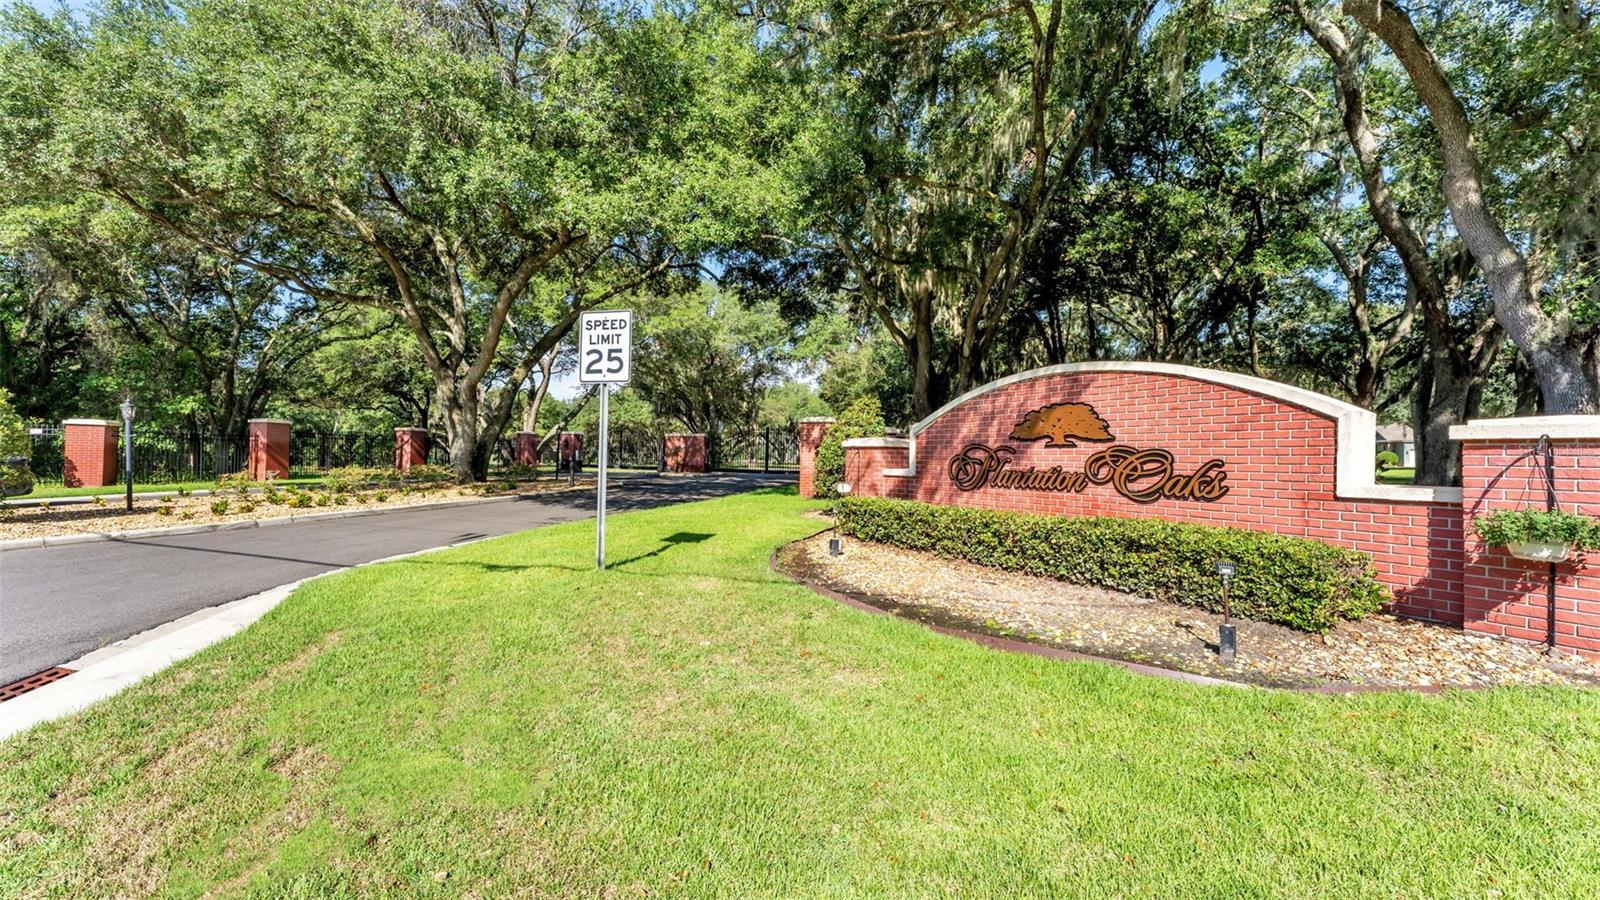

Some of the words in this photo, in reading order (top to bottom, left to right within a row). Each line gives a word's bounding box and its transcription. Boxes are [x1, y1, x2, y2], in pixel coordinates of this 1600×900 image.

[585, 319, 627, 331] SPEED
[589, 333, 622, 345] LIMIT
[585, 348, 624, 374] 25
[949, 444, 1089, 492] Plantation
[1084, 446, 1229, 504] Oaks
